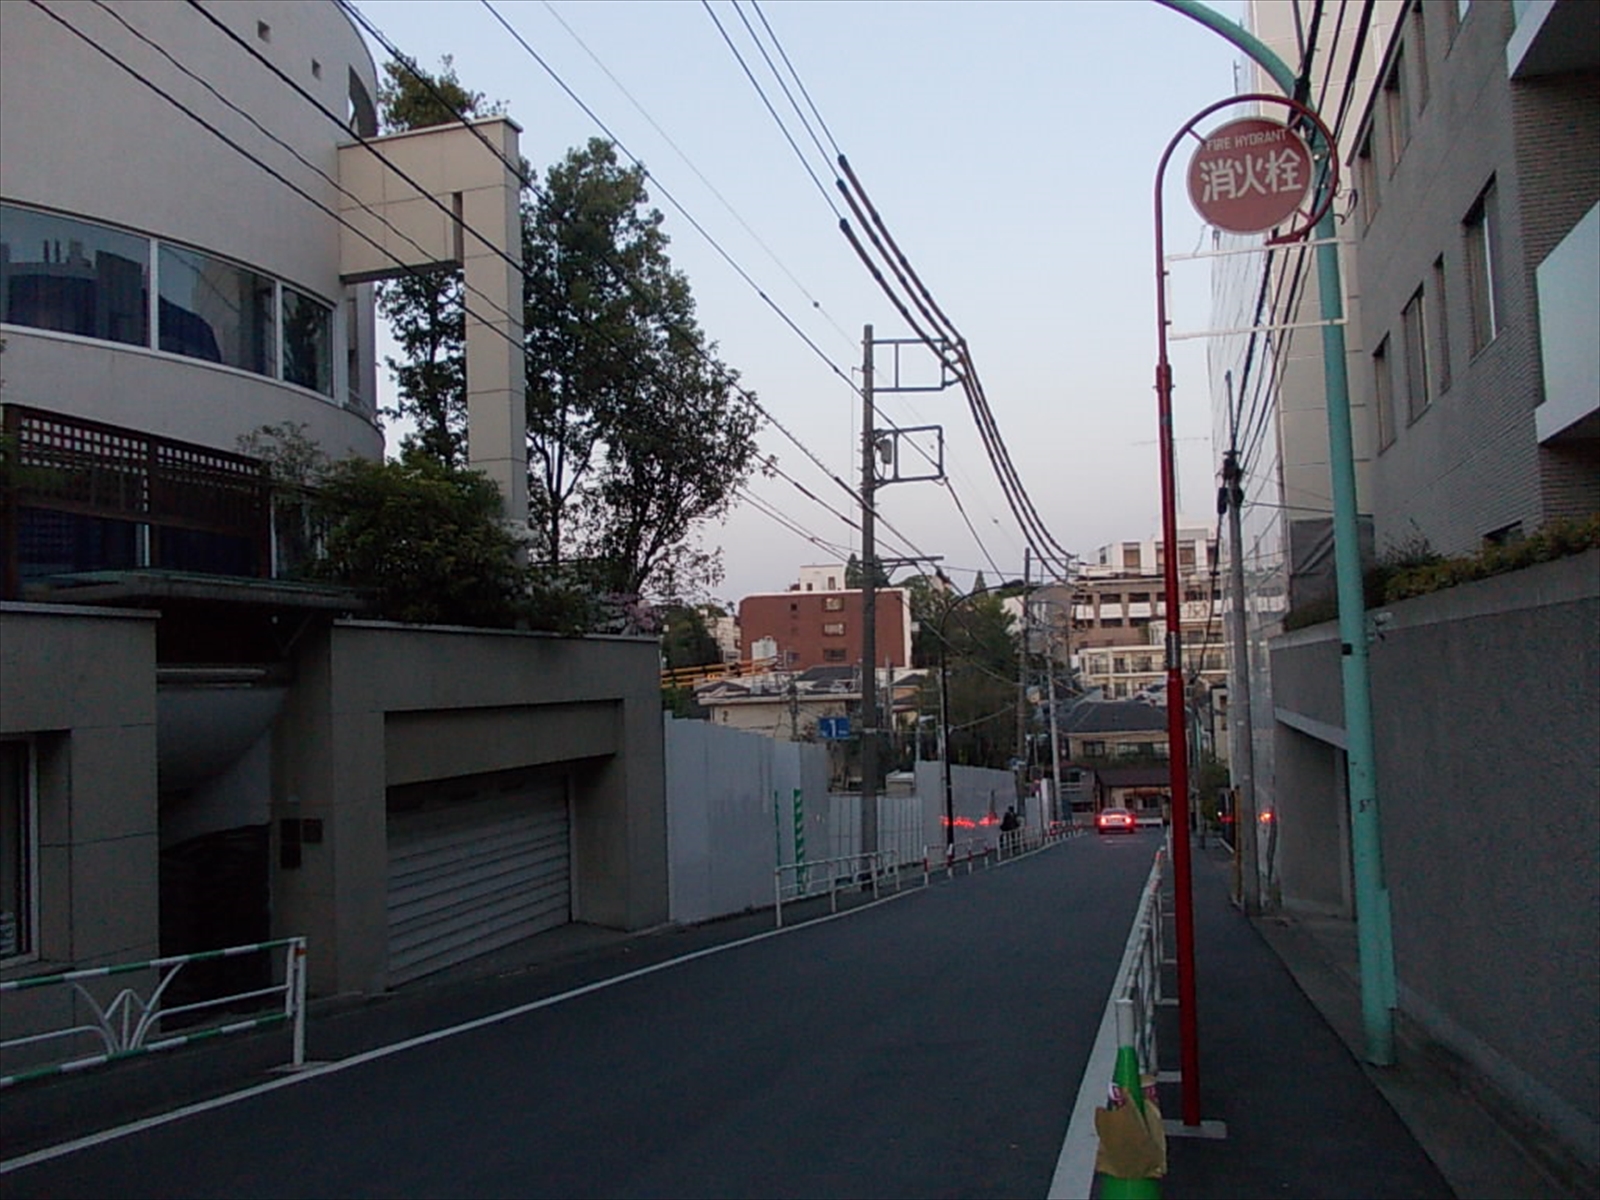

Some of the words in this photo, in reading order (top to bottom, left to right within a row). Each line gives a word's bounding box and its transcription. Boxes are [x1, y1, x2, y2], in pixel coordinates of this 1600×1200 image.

[1206, 137, 1232, 151] FIRE
[1235, 128, 1288, 147] HYDRANT
[1199, 148, 1303, 204] 消火栓
